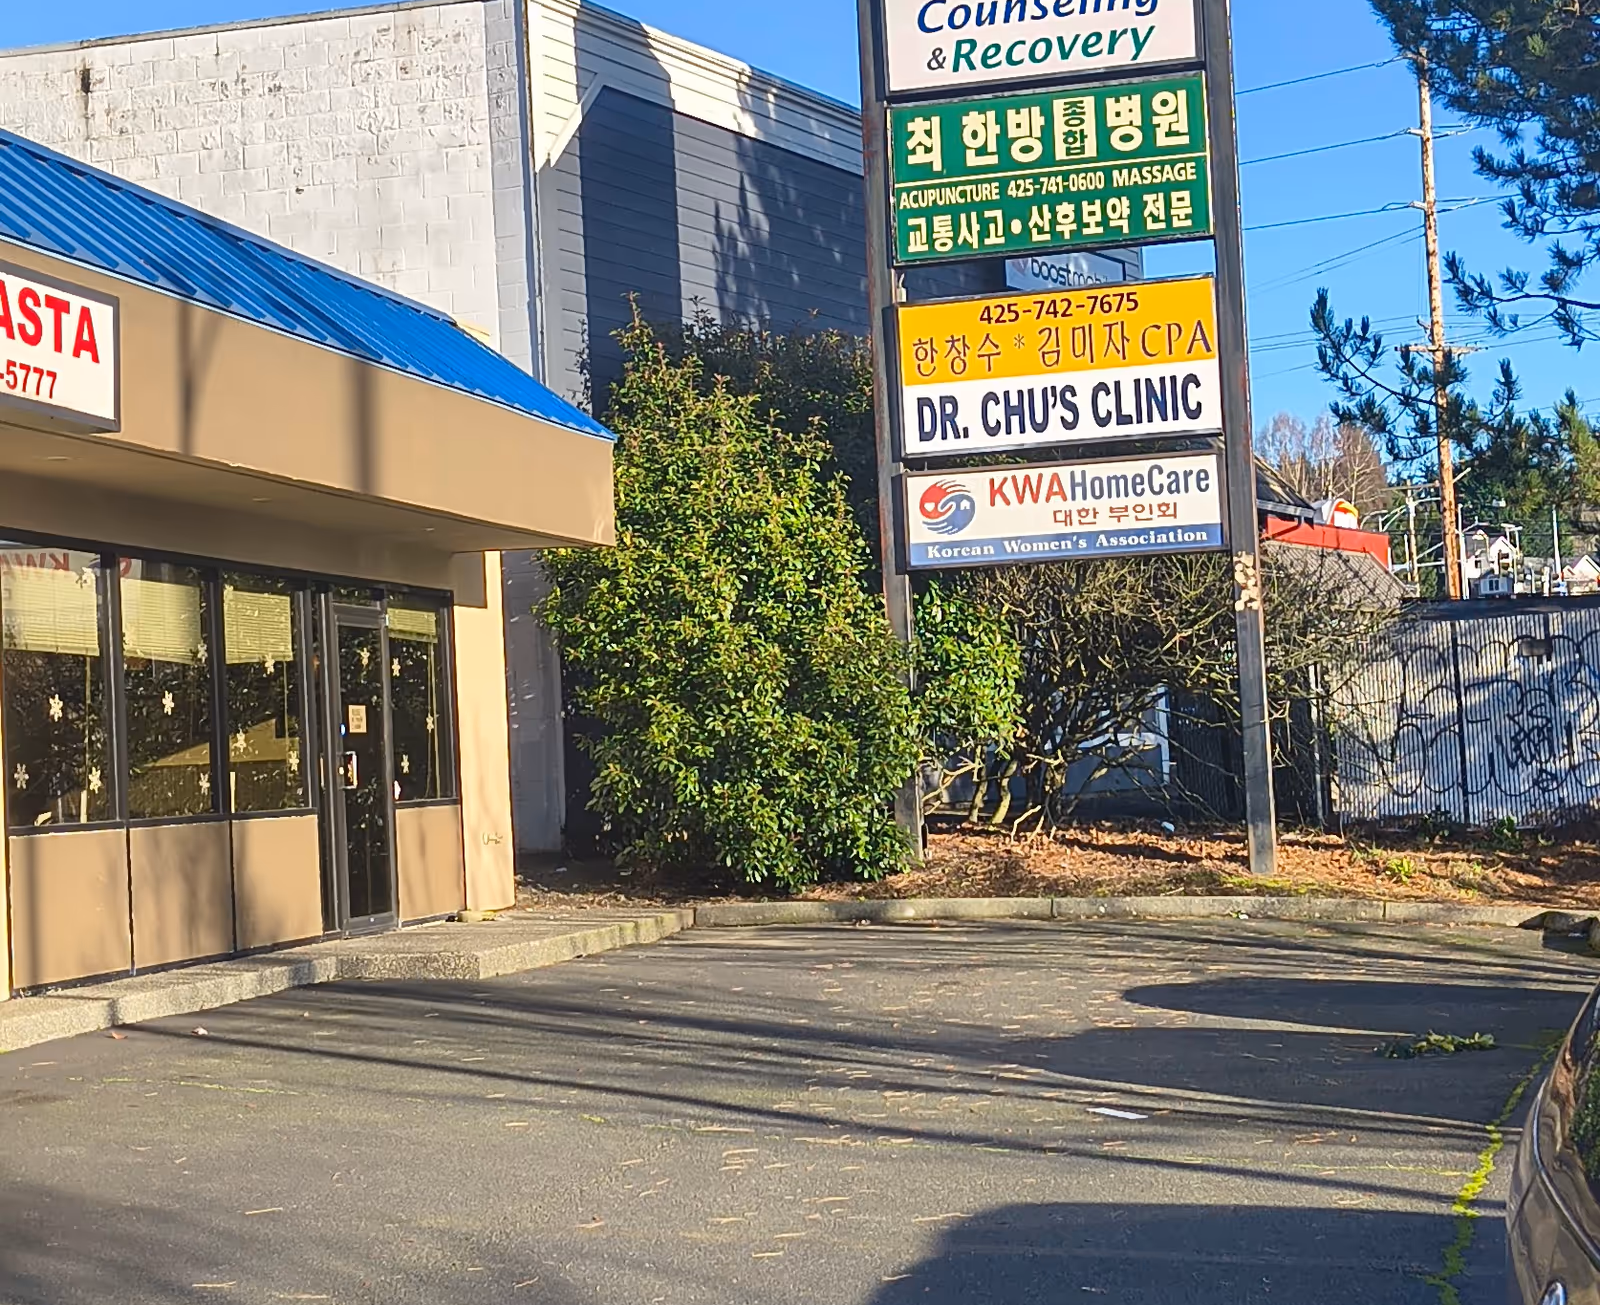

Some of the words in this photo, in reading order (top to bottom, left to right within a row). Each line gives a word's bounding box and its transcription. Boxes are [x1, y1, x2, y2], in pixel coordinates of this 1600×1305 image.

[906, 116, 943, 172] 최
[899, 182, 1000, 210] ACUPUNCTURE
[1007, 171, 1105, 198] 425-741-0600
[1112, 162, 1197, 188] MASSAGE
[1143, 190, 1193, 229] 전문
[979, 291, 1139, 325] 425-742-7675
[913, 332, 1002, 378] 한창수
[1038, 321, 1131, 368] 김미자
[1141, 319, 1213, 359] CPA
[916, 395, 969, 442] DR.
[981, 385, 1079, 436] CHU'S
[1091, 373, 1202, 429] CLINIC
[1053, 506, 1100, 527] 대한
[1108, 502, 1178, 523] 부인회
[927, 542, 995, 559] Korean
[1002, 535, 1088, 553] Women's
[1096, 528, 1208, 548] Association
